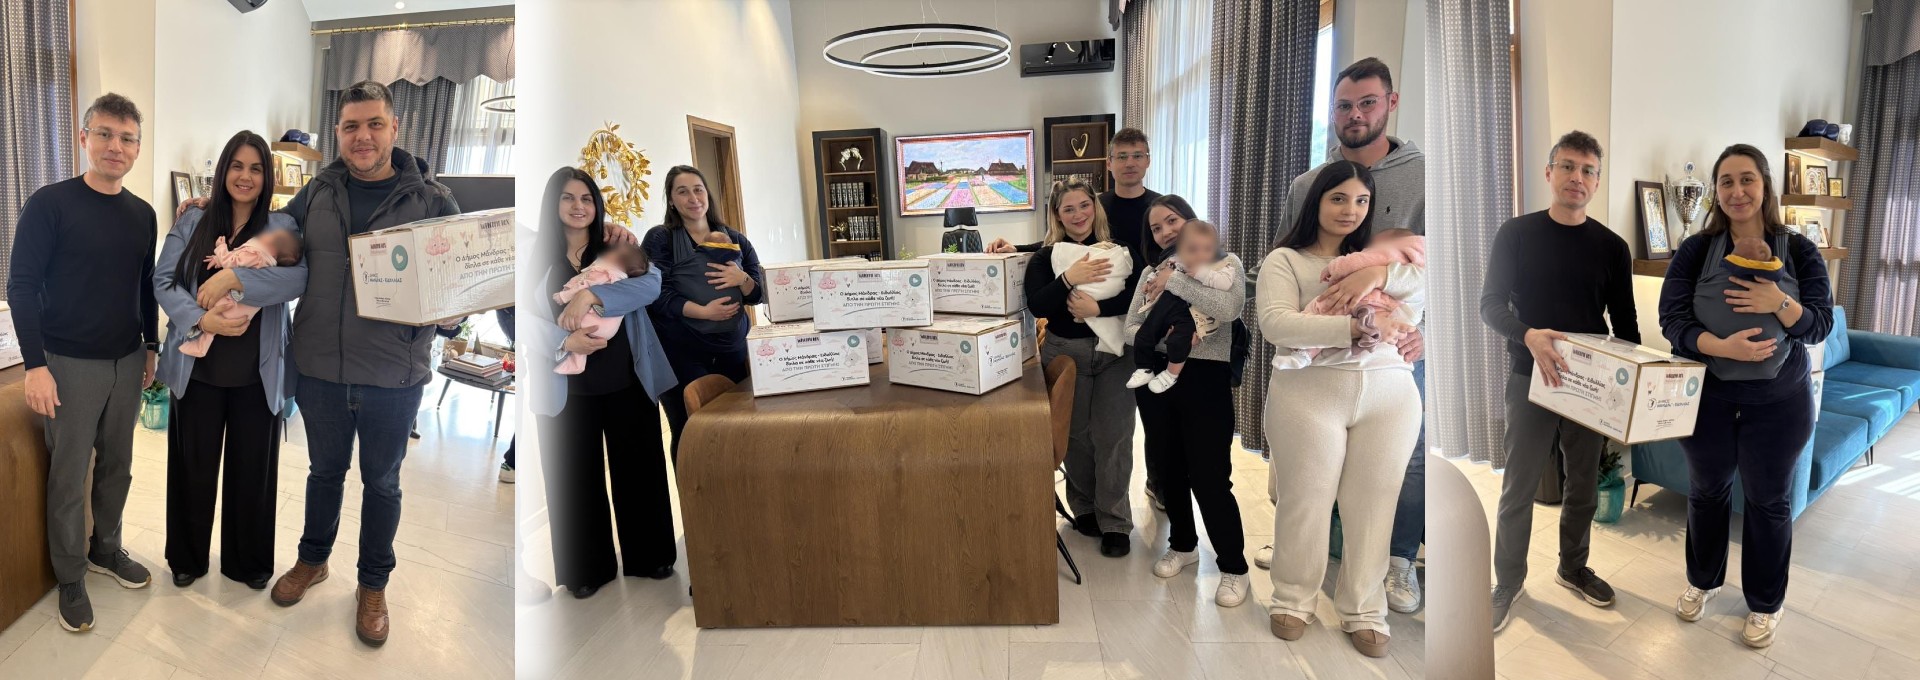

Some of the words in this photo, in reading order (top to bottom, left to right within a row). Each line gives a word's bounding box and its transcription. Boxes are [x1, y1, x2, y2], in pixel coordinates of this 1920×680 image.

[481, 248, 506, 258] Μάνδρας
[491, 256, 504, 264] κάθε
[460, 271, 473, 280] ΑΠΟ
[489, 264, 510, 274] ΠΡΩΤΗ
